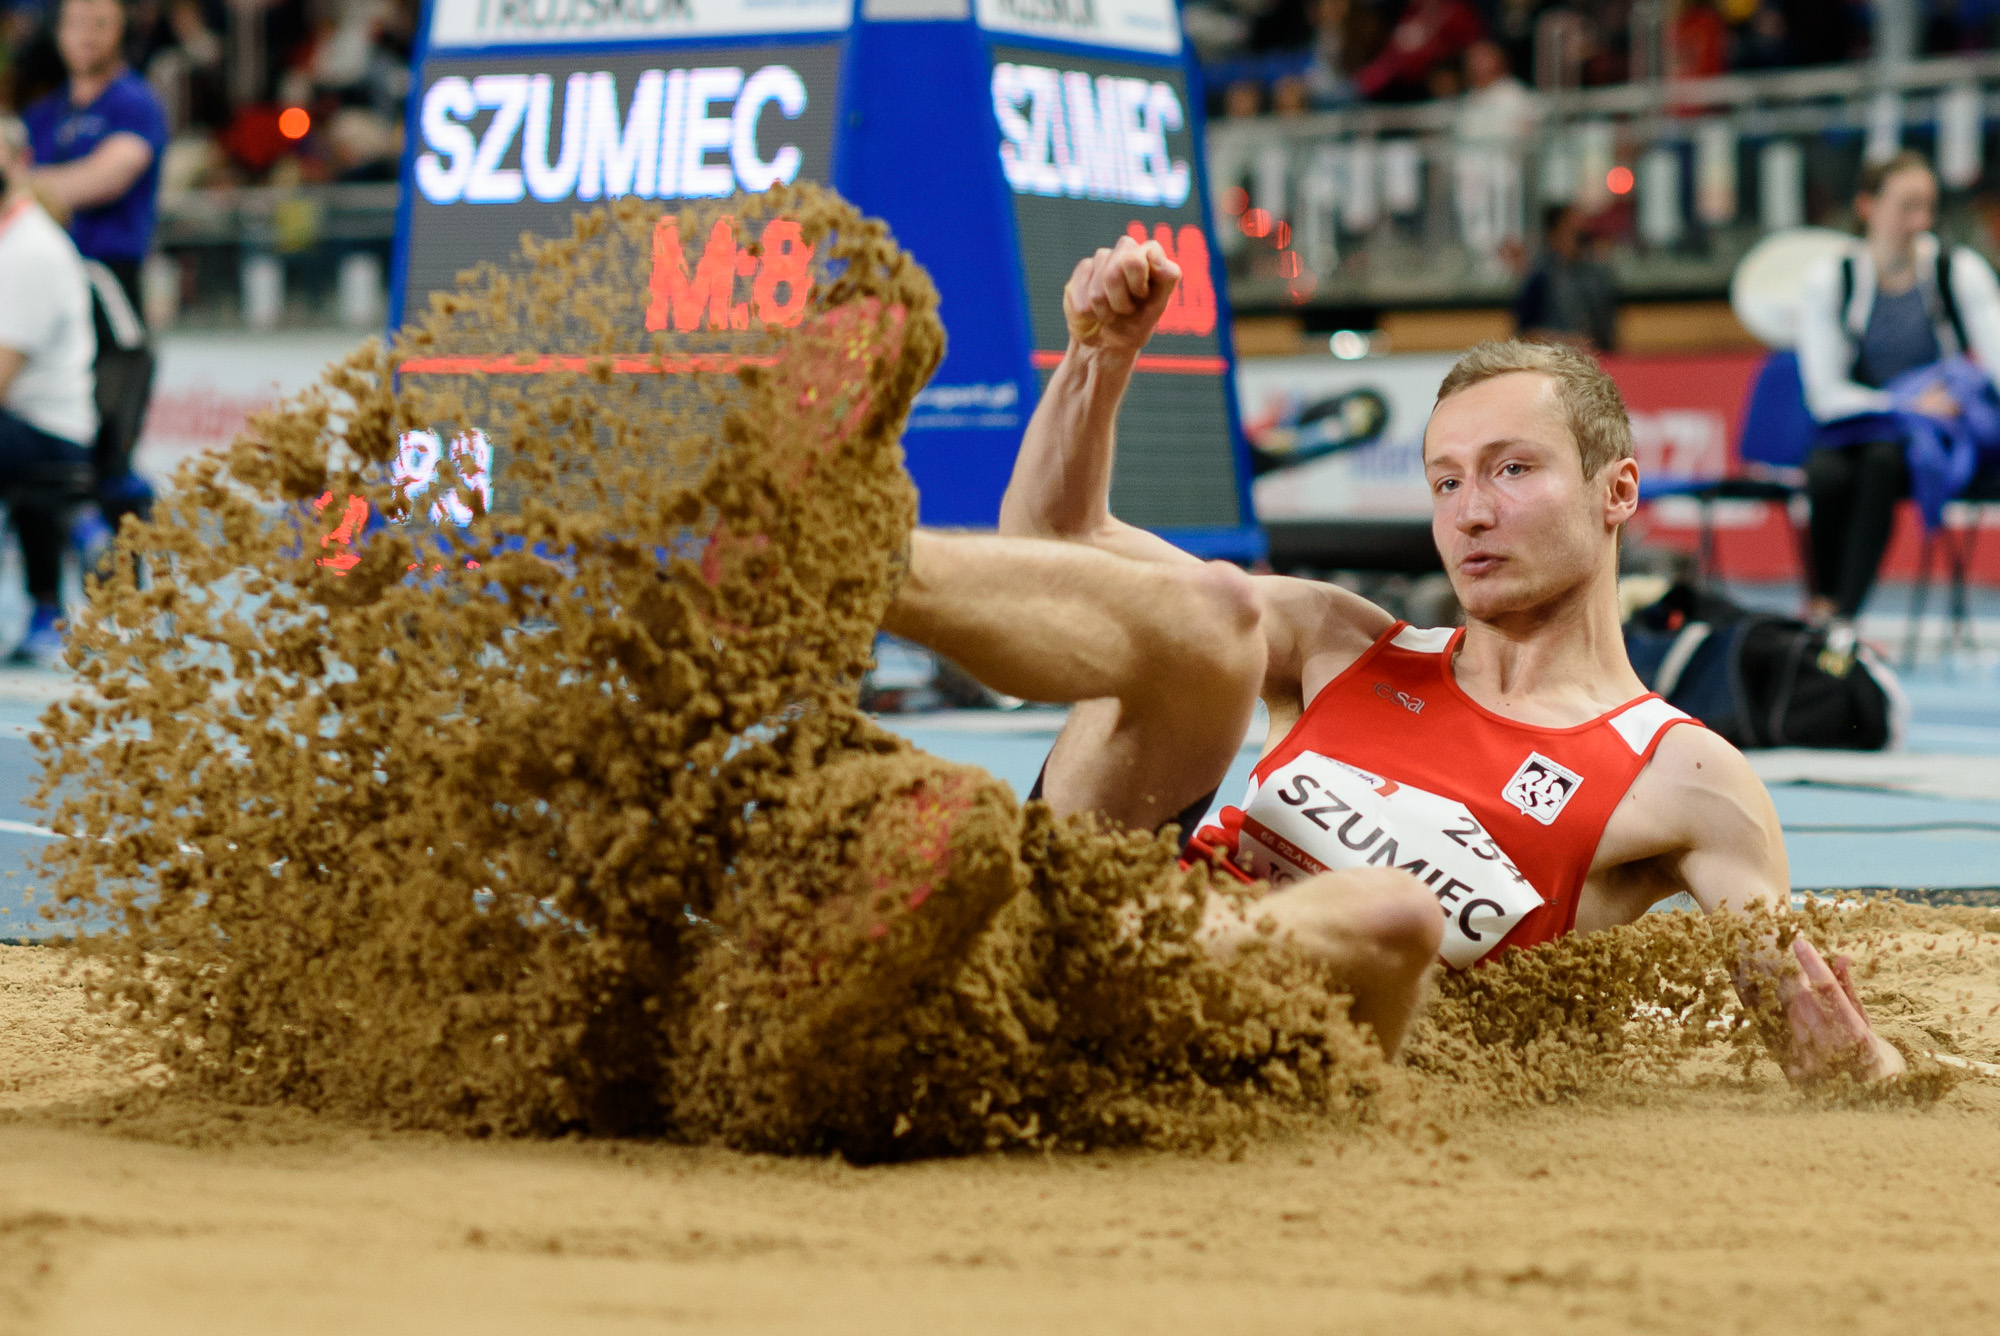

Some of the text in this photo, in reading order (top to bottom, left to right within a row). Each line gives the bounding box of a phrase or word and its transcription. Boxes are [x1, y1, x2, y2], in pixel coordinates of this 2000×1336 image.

[414, 63, 808, 205] SZUMIEC
[991, 62, 1192, 209] SZUMIEC
[1277, 774, 1506, 942] SZUMIEC
[1441, 816, 1526, 885] 254
